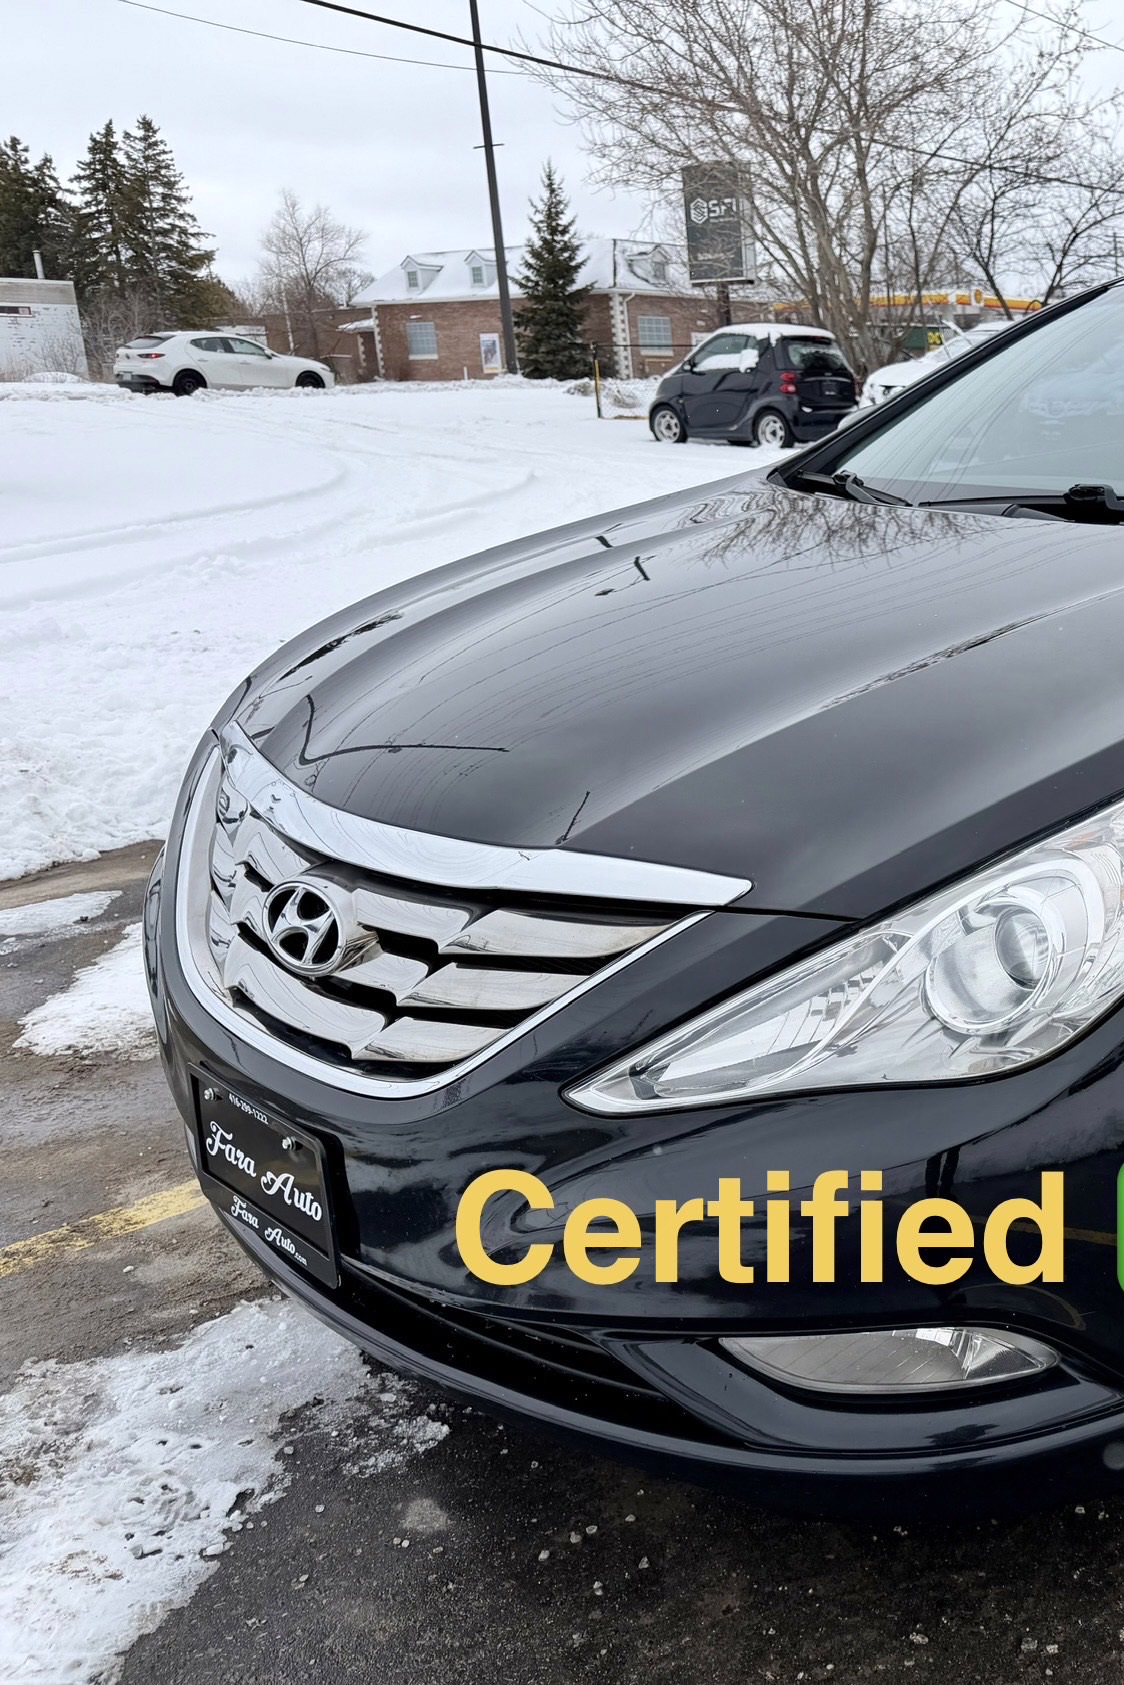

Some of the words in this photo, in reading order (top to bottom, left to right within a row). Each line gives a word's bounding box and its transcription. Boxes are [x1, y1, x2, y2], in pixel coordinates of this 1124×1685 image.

[205, 1120, 257, 1178] Fara
[260, 1170, 322, 1222] Auto
[230, 1195, 259, 1229] Fara
